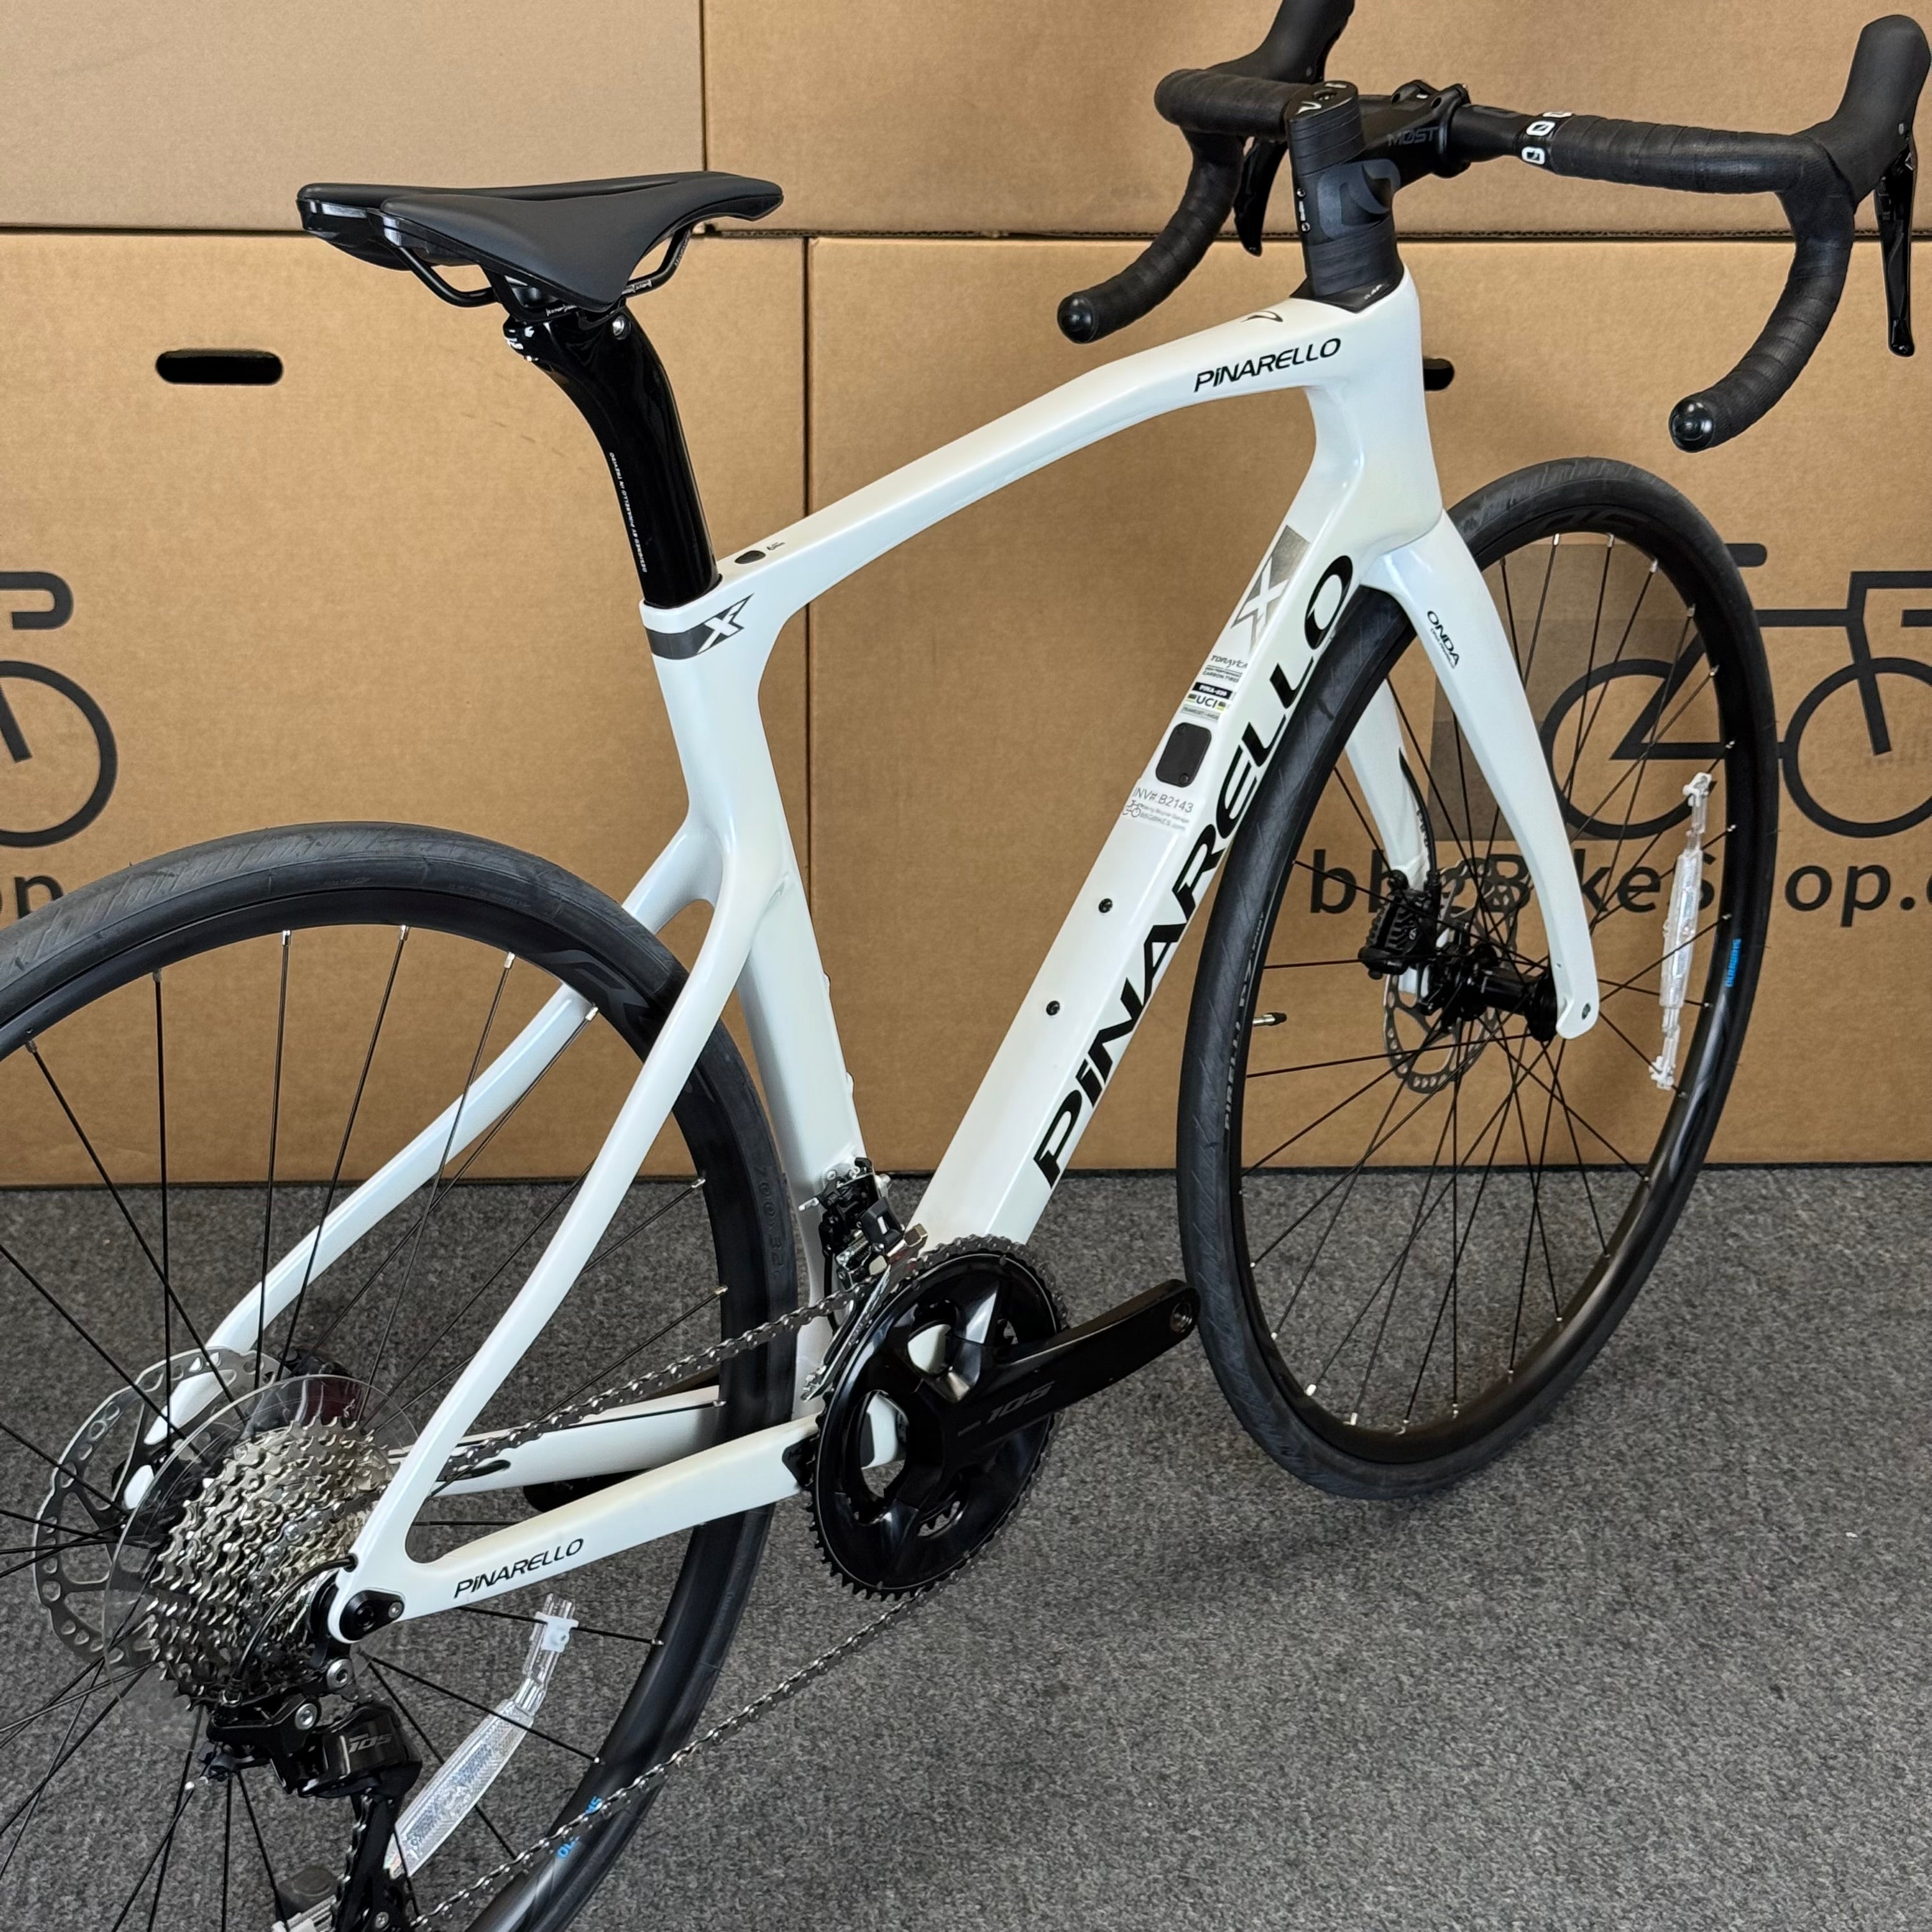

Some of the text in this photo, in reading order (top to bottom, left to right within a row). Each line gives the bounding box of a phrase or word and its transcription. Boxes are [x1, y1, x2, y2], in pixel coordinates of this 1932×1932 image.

[1193, 338, 1341, 393] PINARELLO
[621, 489, 636, 528] PINARELLO
[1427, 611, 1459, 666] ONDA
[1196, 695, 1218, 709] UCI
[1158, 794, 1193, 813] B2143
[1033, 555, 1353, 1189] PINARELLO
[987, 1380, 1055, 1424] 105
[454, 1538, 584, 1598] PINARELLO
[348, 1733, 393, 1753] 105
